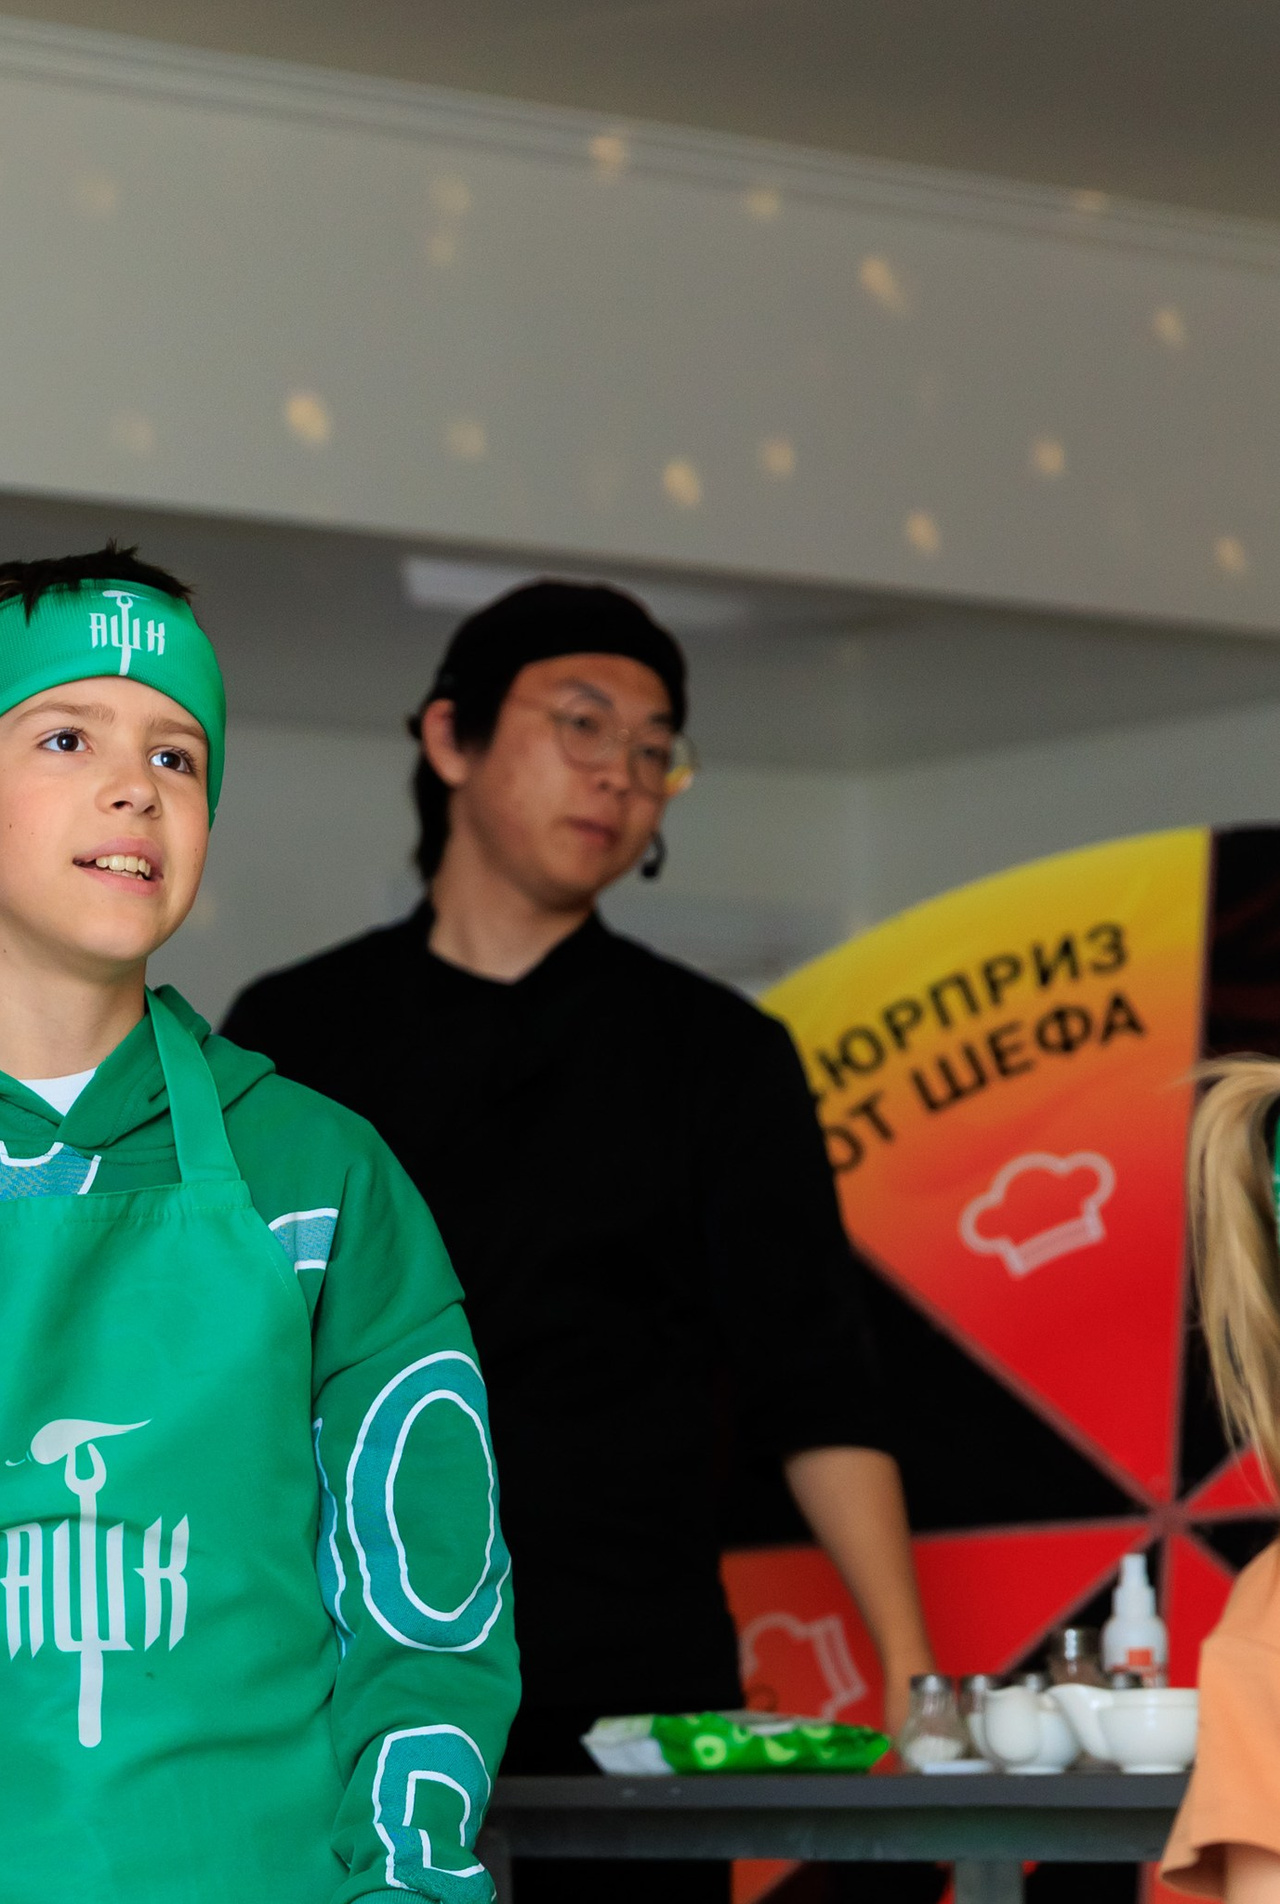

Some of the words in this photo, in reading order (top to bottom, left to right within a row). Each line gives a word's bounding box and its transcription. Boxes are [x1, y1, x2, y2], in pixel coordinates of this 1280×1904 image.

[814, 922, 1130, 1092] ЮРПРИЗ
[821, 1093, 896, 1174] ОТ
[910, 992, 1147, 1115] ШЕФА
